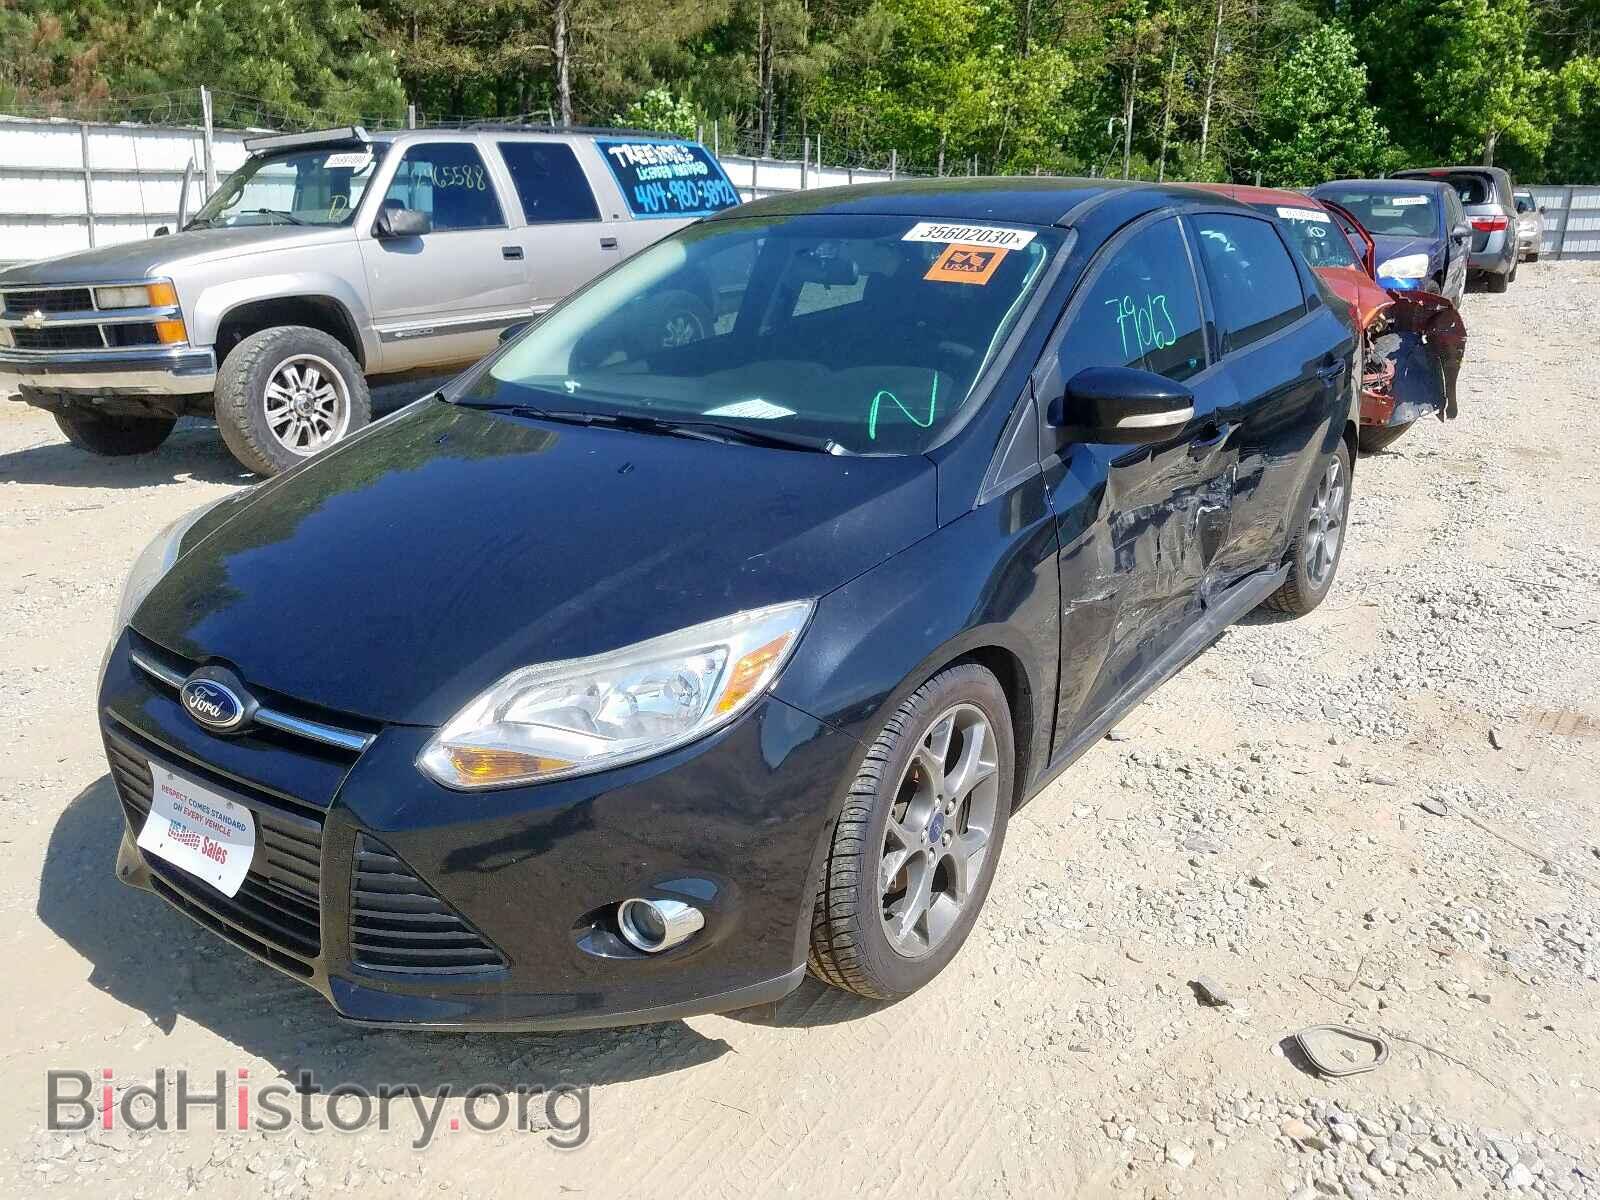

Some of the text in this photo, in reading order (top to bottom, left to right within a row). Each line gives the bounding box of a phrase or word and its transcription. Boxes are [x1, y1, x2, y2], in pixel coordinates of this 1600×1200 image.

[920, 226, 1007, 245] 35602030
[943, 262, 979, 272] USAA
[1105, 293, 1176, 362] 79063
[189, 686, 225, 717] Ford
[160, 784, 247, 832] RESPECT COMES STANDARD
[173, 802, 231, 838] ON EVERY VEHICLE
[201, 836, 228, 865] Sales
